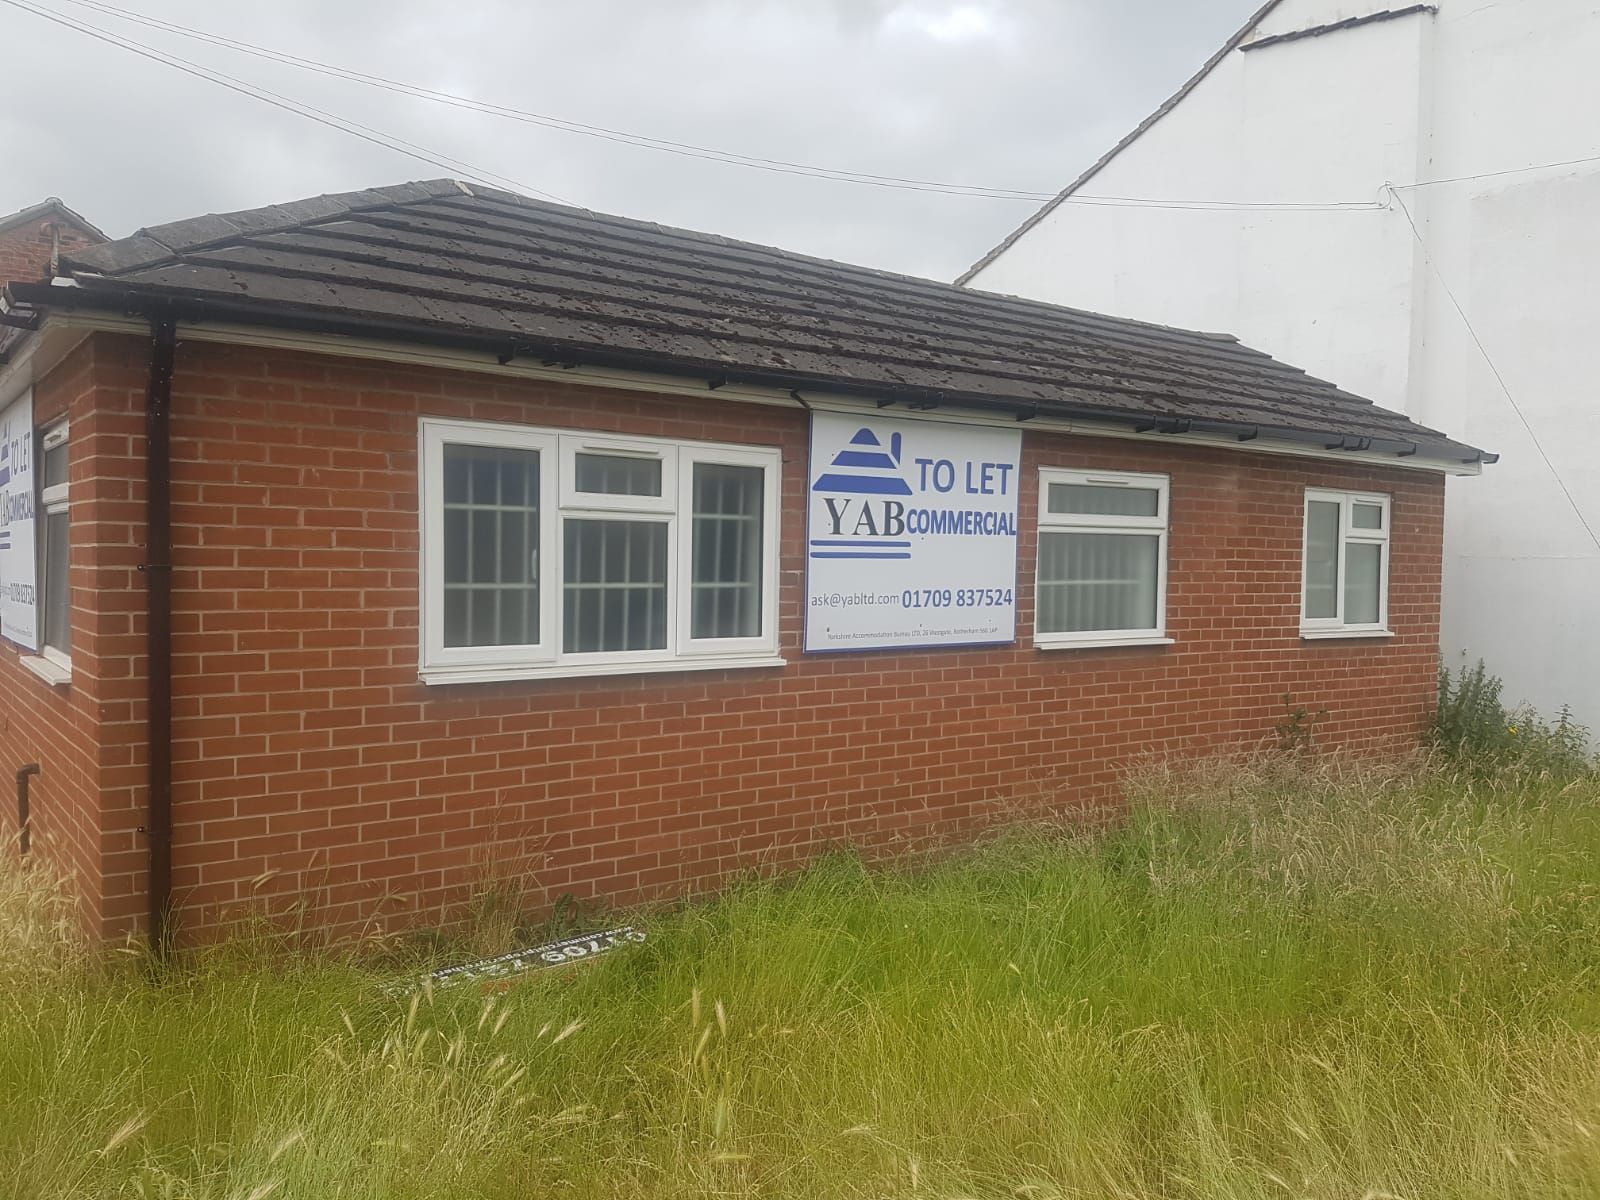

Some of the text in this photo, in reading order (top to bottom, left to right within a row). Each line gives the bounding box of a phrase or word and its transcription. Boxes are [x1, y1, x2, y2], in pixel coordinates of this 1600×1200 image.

[11, 431, 31, 477] TO LET
[915, 458, 1014, 495] TO LET
[823, 498, 1017, 536] YAB COMMERCIAL
[811, 588, 1013, 608] ask@yabltd.com 01709 837524
